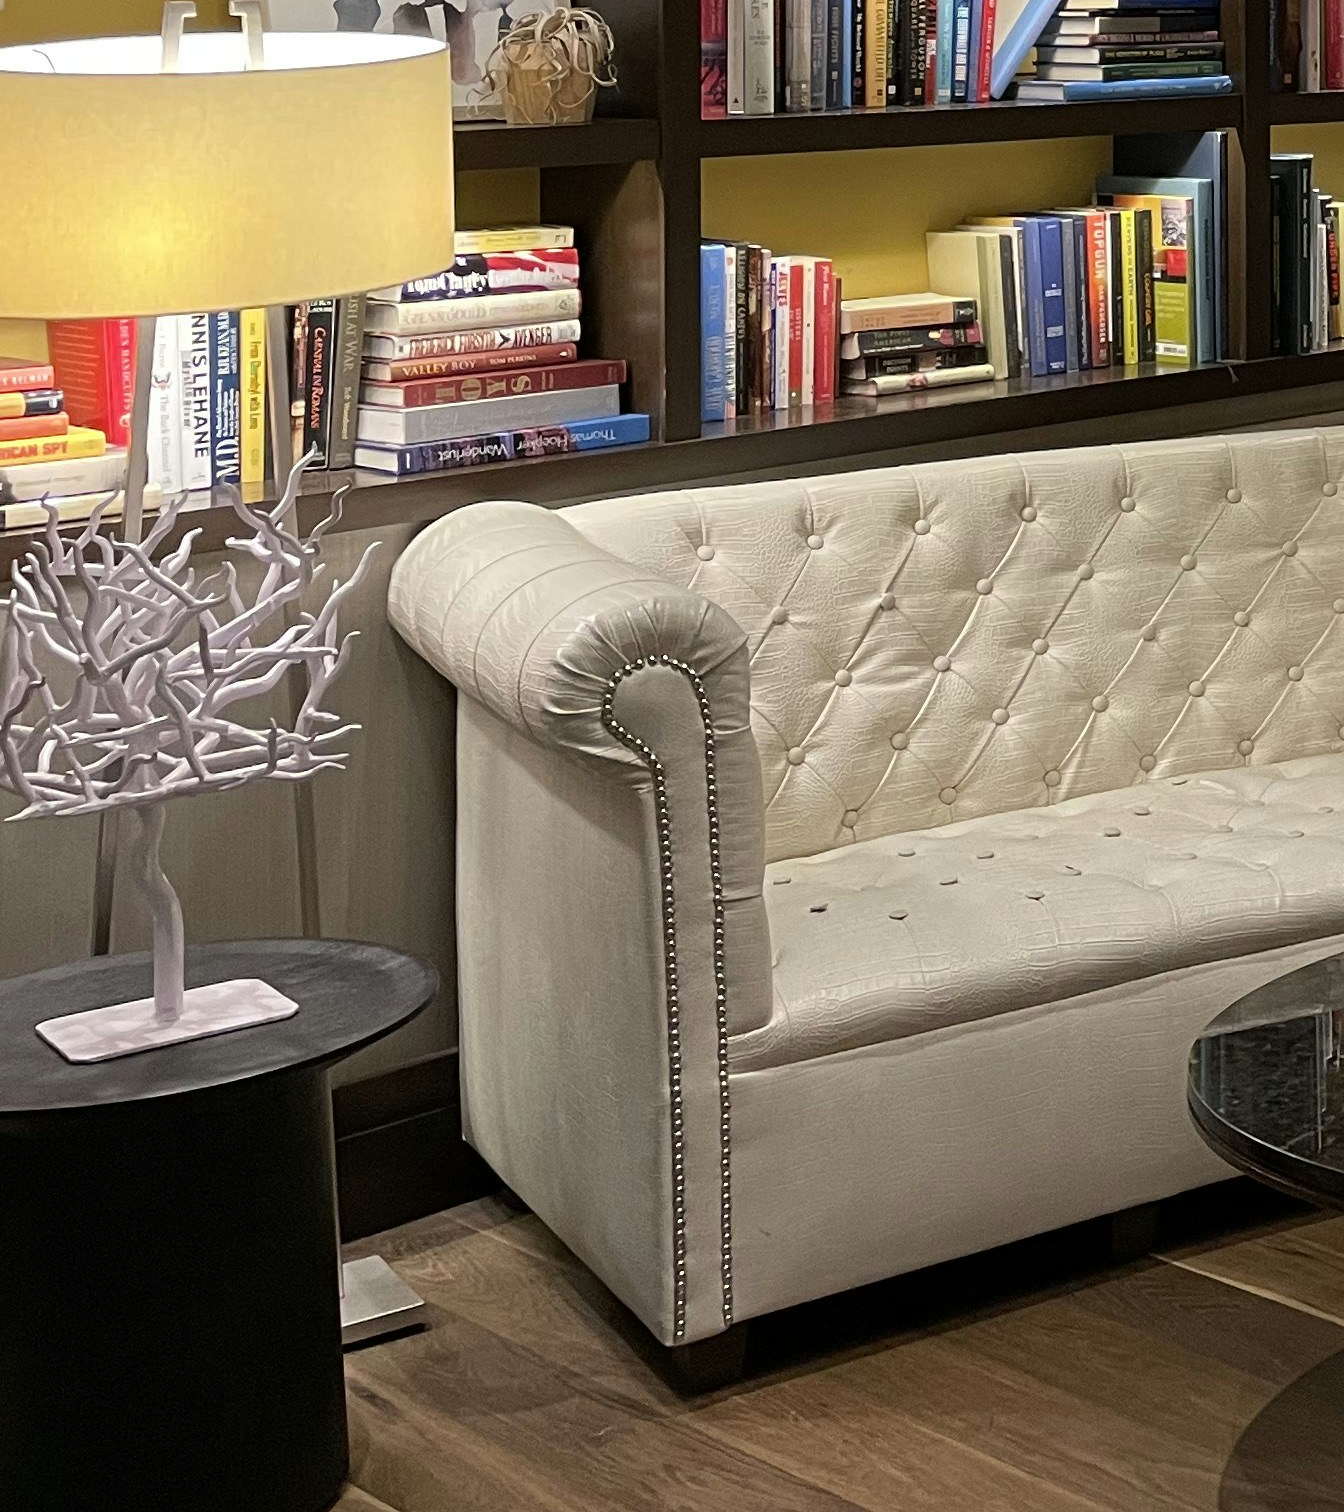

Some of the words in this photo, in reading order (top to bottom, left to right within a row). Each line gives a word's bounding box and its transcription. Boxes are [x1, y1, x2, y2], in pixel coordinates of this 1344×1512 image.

[873, 8, 884, 65] COMMITTED
[918, 15, 927, 81] FERGUSON
[910, 49, 918, 80] TOWER
[1094, 221, 1106, 279] TOPGUN
[1127, 265, 1136, 296] EARTH
[513, 326, 553, 347] AVENGER
[1098, 302, 1106, 343] PEDERSEN
[313, 327, 328, 374] CARNIVAL
[341, 339, 359, 374] WAR
[874, 336, 912, 346] AMERICAN
[312, 374, 323, 386] IN
[402, 362, 447, 378] VALLEY
[451, 359, 477, 371] BOY
[192, 372, 210, 459] LEHANE
[310, 386, 324, 429] ROMANS
[341, 401, 352, 441] Woodward
[43, 440, 69, 456] SPY
[438, 442, 510, 461] Wanderlust
[516, 434, 568, 452] Hoepker
[569, 428, 617, 442] Thomas
[159, 436, 172, 473] Channel
